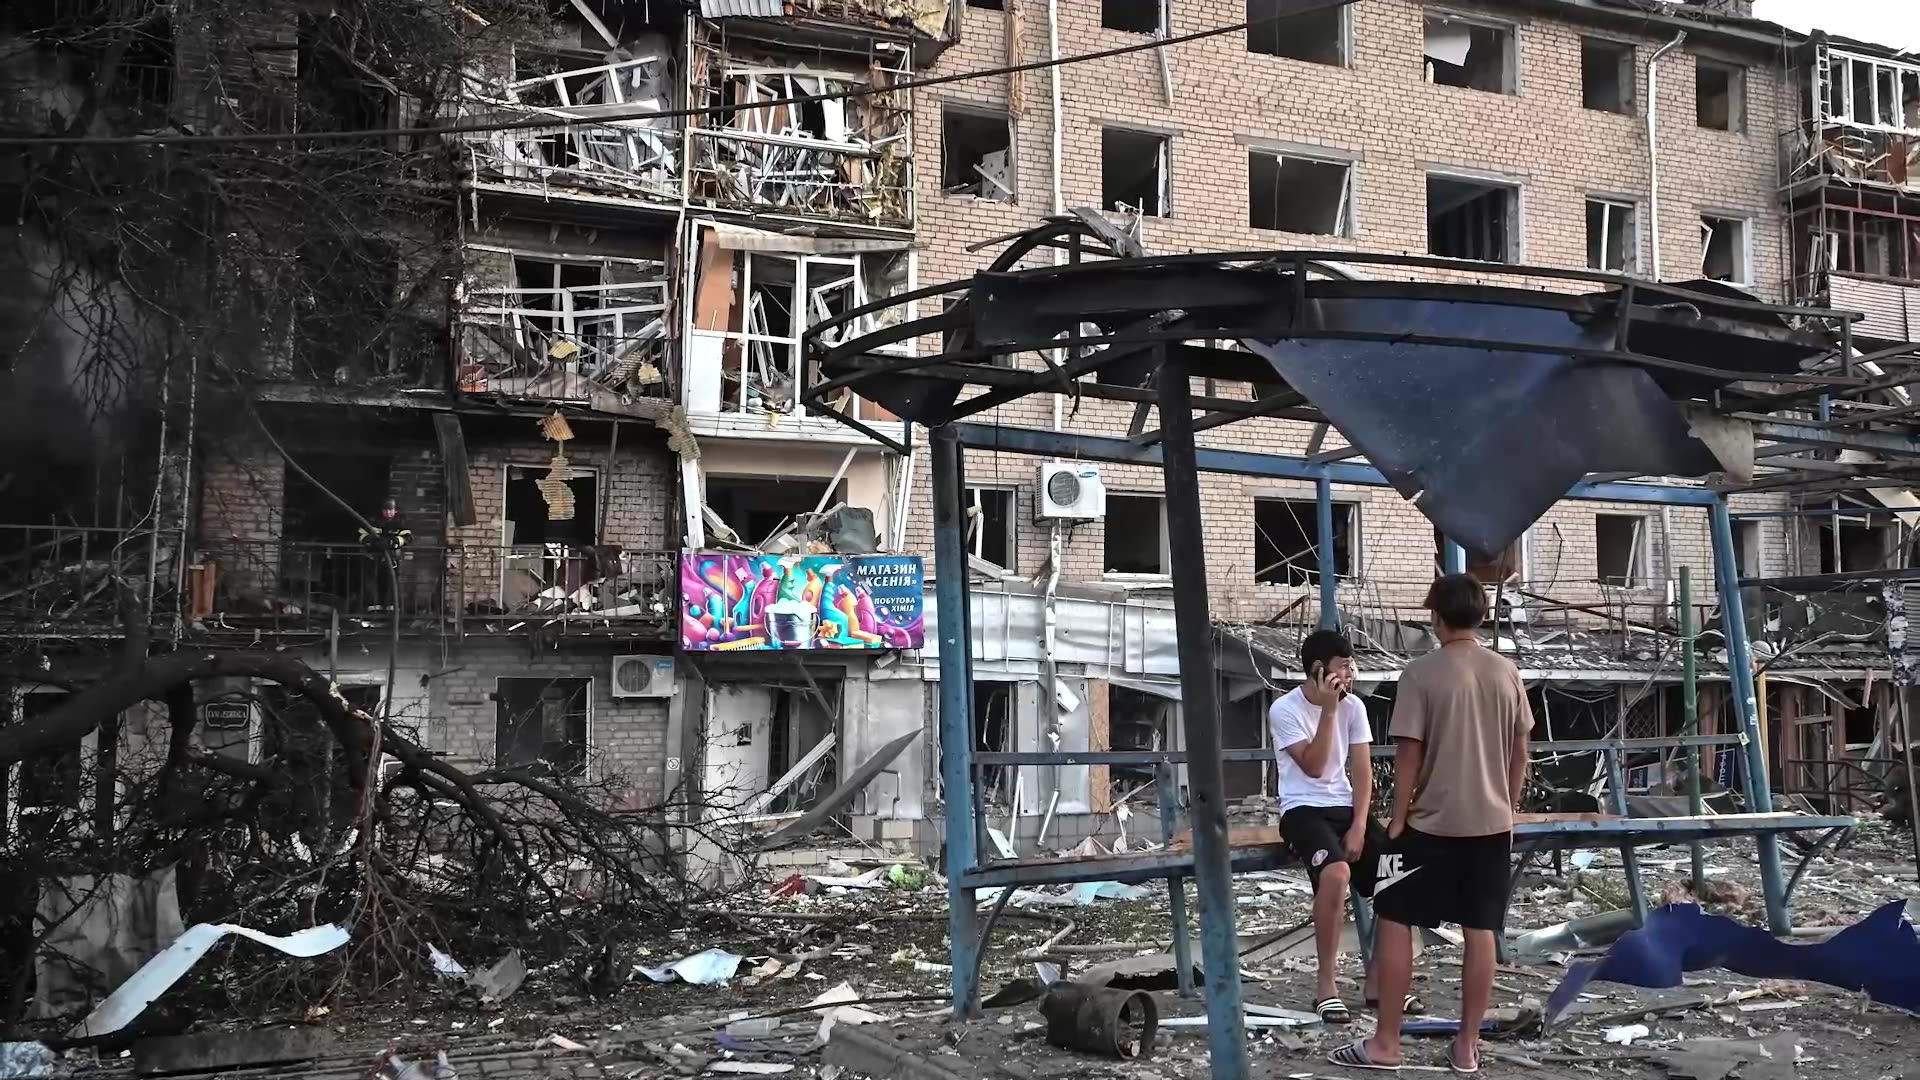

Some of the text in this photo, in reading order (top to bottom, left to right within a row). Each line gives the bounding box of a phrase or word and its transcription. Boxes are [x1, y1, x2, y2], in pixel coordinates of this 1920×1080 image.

[856, 564, 917, 576] МАГАЗИН
[874, 597, 916, 605] ПОБУТОВА
[891, 605, 914, 613] ХІМІЯ
[1376, 853, 1403, 878] IKE
